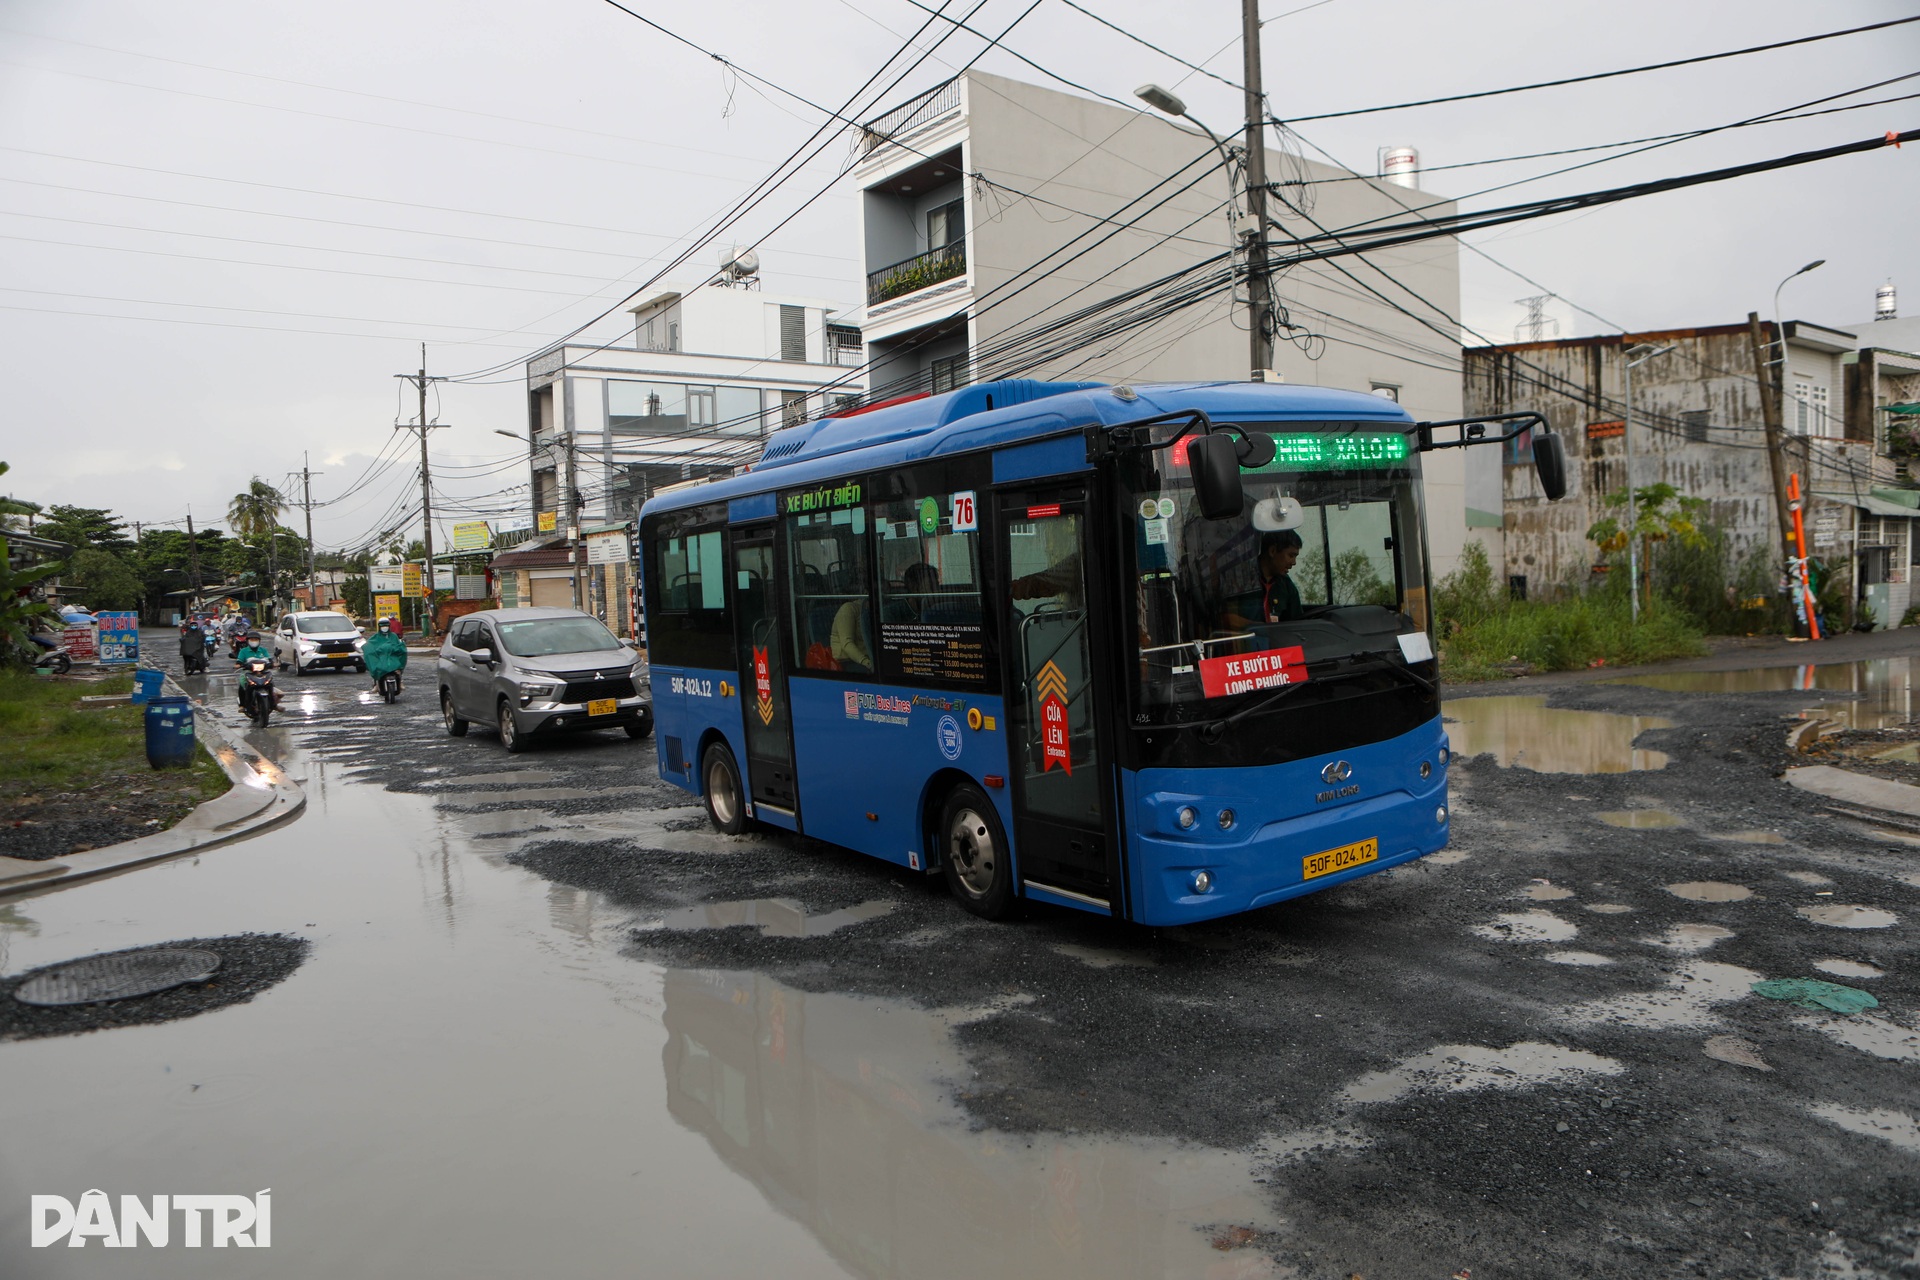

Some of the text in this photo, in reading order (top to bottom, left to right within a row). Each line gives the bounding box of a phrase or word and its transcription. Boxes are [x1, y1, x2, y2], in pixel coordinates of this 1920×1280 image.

[787, 481, 861, 513] XE BUÝT ĐIỆN
[955, 497, 974, 525] 76
[1226, 655, 1283, 677] XE BUÝT ĐI
[671, 677, 712, 697] 50F-024.12
[1225, 679, 1254, 696] LONG
[857, 692, 911, 713] FUTA Bus Lines
[1046, 700, 1062, 722] CỬA
[1047, 724, 1063, 745] LÊN
[1046, 745, 1067, 758] Entrance
[1316, 784, 1361, 804] KIM LONG
[1309, 843, 1372, 874] 50F-024.12
